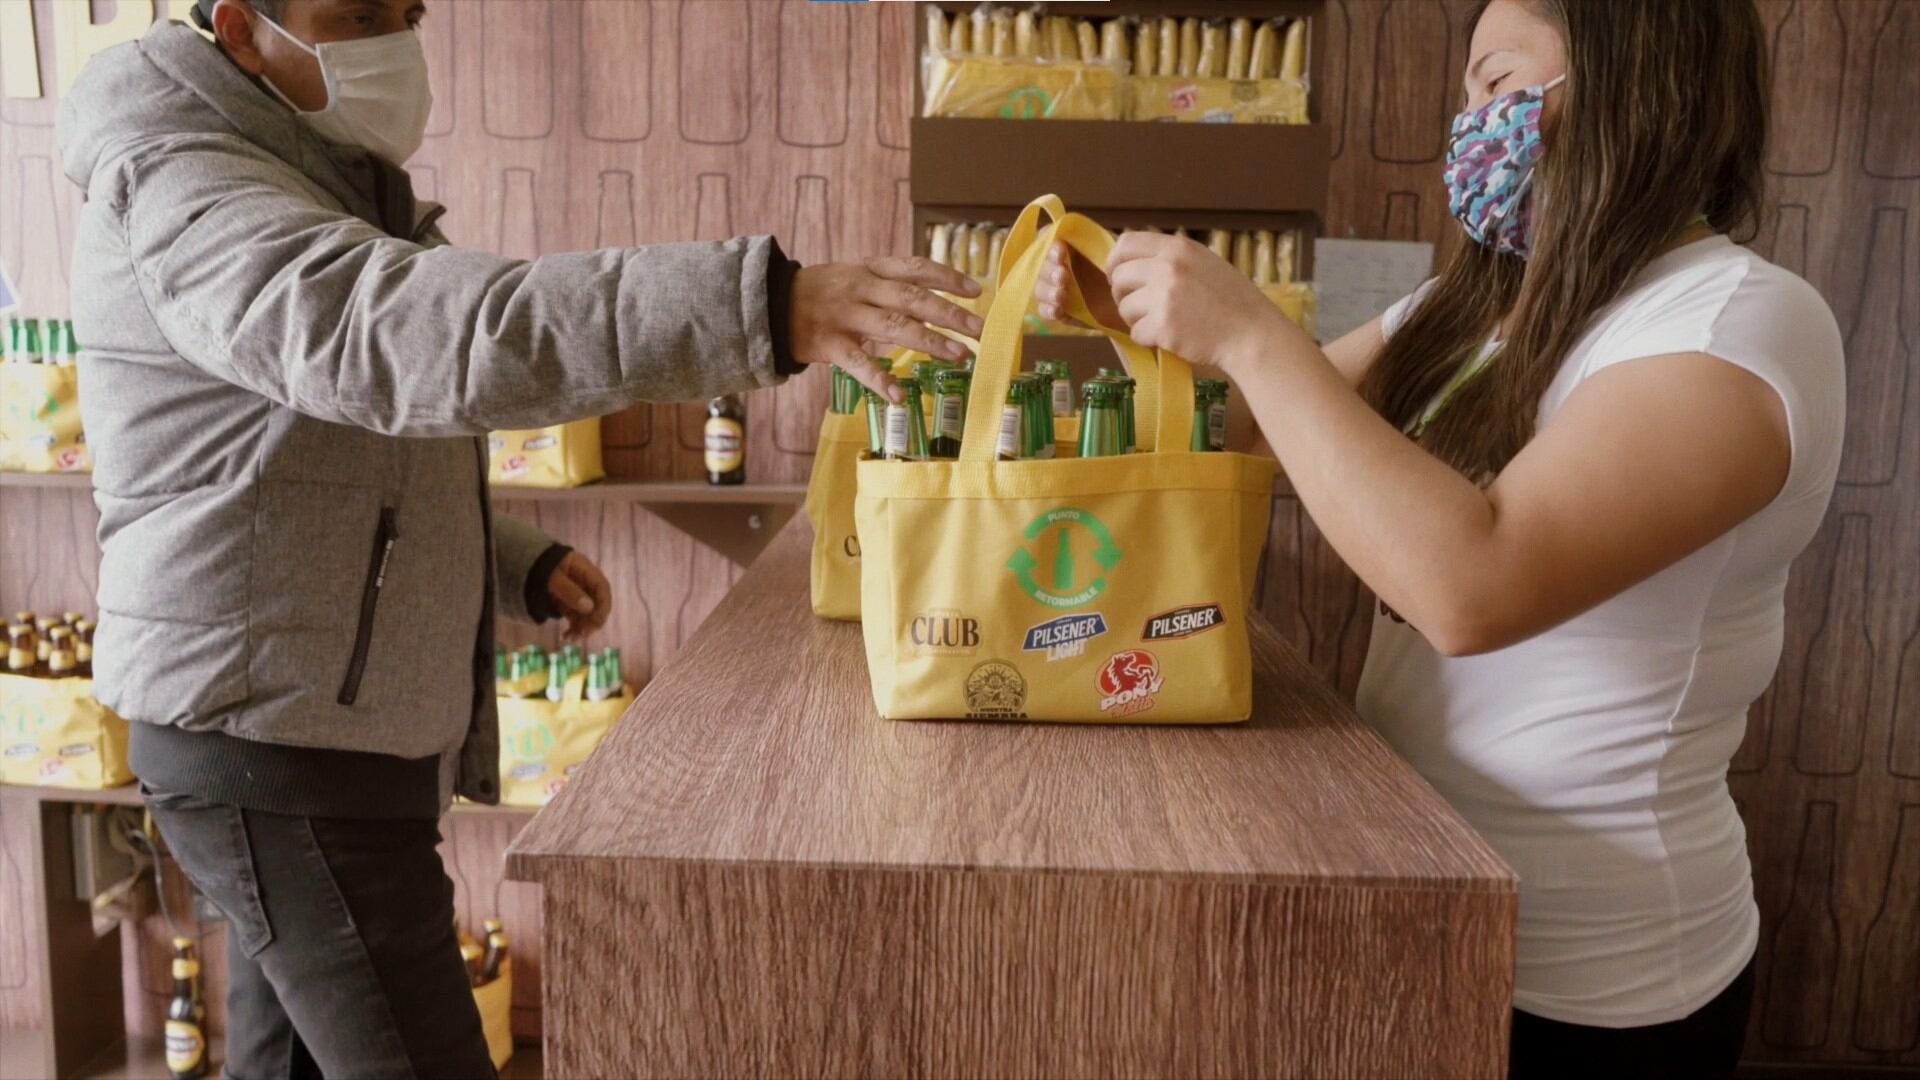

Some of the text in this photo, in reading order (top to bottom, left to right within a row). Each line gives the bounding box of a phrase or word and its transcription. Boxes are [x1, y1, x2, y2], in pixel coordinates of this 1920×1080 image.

[1048, 511, 1080, 524] PUNTO
[910, 616, 980, 647] CLUB
[1033, 617, 1097, 647] PILSENER
[1151, 607, 1216, 637] PILSENER
[1046, 638, 1088, 662] LIGHT
[1100, 677, 1165, 711] PONY
